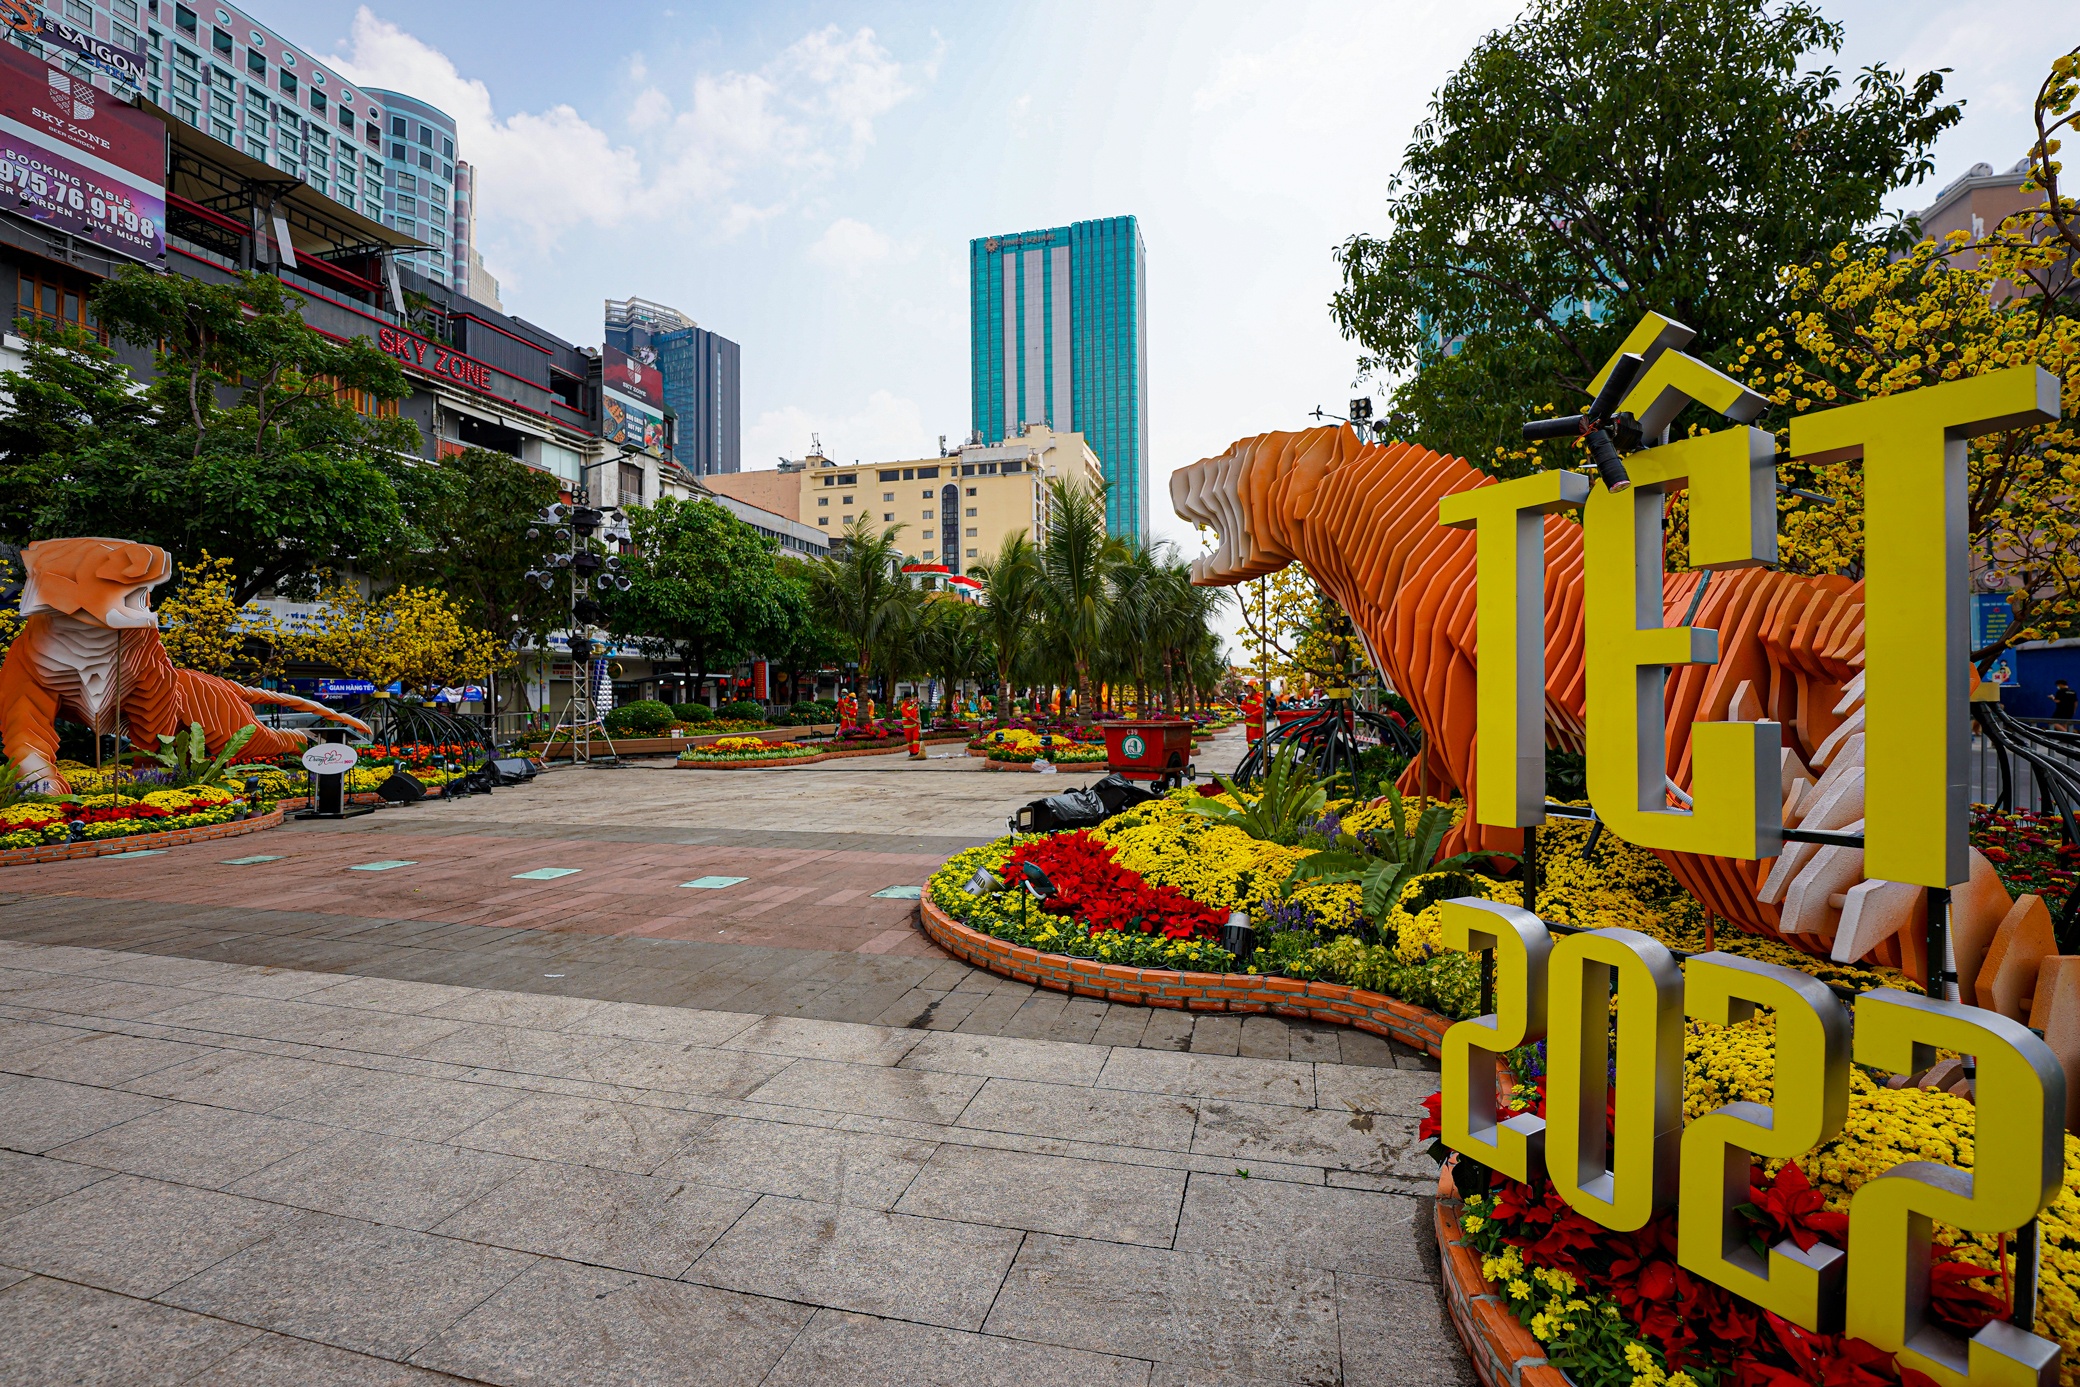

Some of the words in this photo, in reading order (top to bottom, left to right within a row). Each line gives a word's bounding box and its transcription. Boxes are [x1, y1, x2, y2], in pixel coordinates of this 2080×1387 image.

[58, 23, 144, 81] SAIGON
[31, 107, 65, 127] SKY
[68, 124, 111, 149] ZONE
[48, 126, 67, 138] BEER
[67, 134, 96, 150] GARDEN
[6, 148, 81, 187] BOOKING
[86, 182, 132, 208] TABLE
[19, 192, 73, 217] GARDEN
[86, 217, 113, 234] LIVE
[116, 229, 152, 249] MUSIC
[379, 327, 428, 364] SKY
[434, 348, 492, 390] ZONE
[633, 386, 647, 397] ZONE
[1439, 310, 2062, 890] TẾT
[345, 683, 363, 691] HÀNG
[363, 682, 375, 691] TẾT
[1126, 728, 1139, 736] C39
[1440, 895, 2066, 1387] 2022
